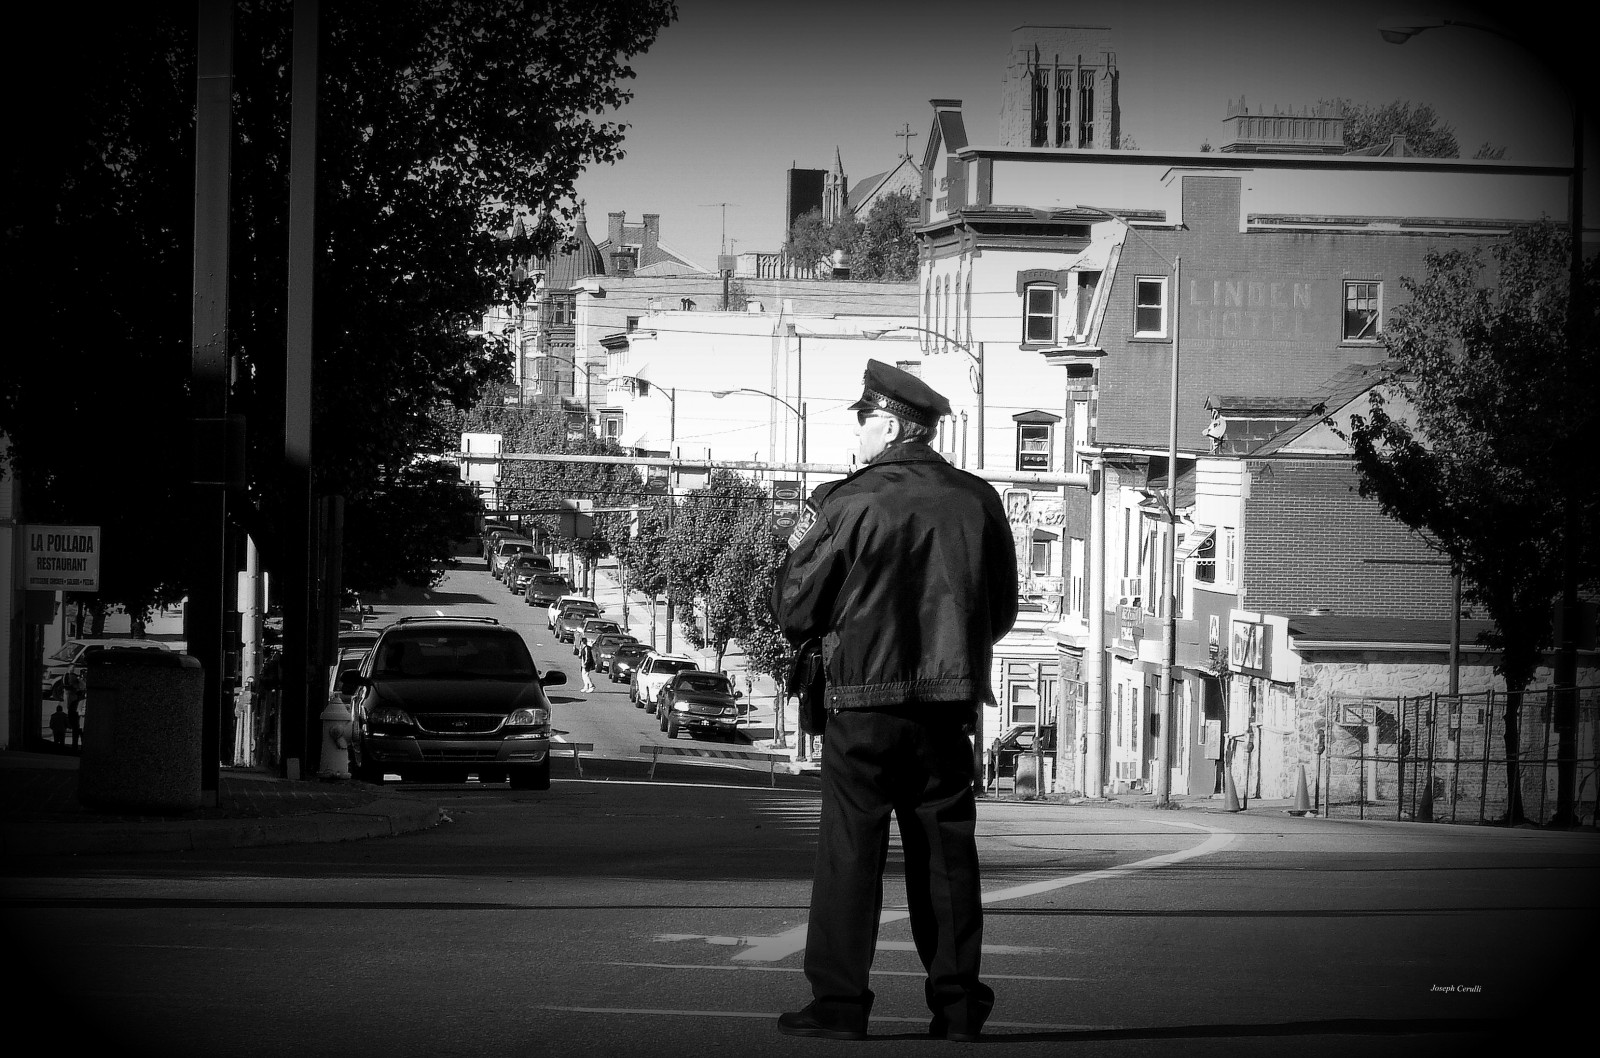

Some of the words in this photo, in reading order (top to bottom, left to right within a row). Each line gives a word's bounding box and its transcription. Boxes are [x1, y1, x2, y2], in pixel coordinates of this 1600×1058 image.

[1190, 280, 1312, 309] LINDEN
[31, 533, 43, 552] LA
[47, 534, 93, 553] POLLADA
[36, 557, 87, 571] RESTAURANT
